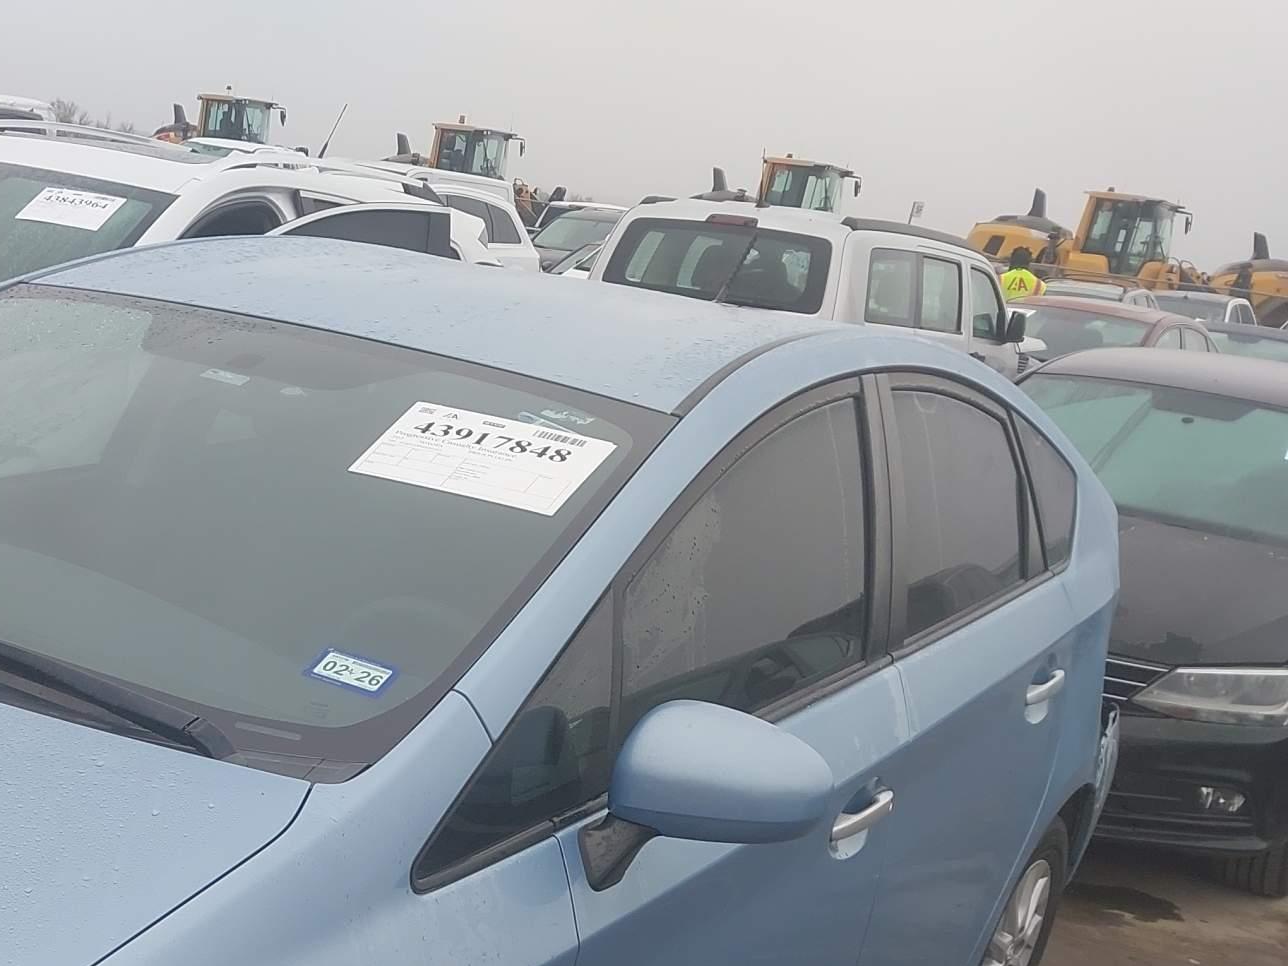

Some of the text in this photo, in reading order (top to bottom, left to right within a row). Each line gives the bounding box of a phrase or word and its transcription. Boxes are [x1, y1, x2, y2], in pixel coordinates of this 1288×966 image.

[43, 195, 109, 210] 43843964
[413, 421, 573, 463] 43917848
[322, 660, 384, 687] 02 26
